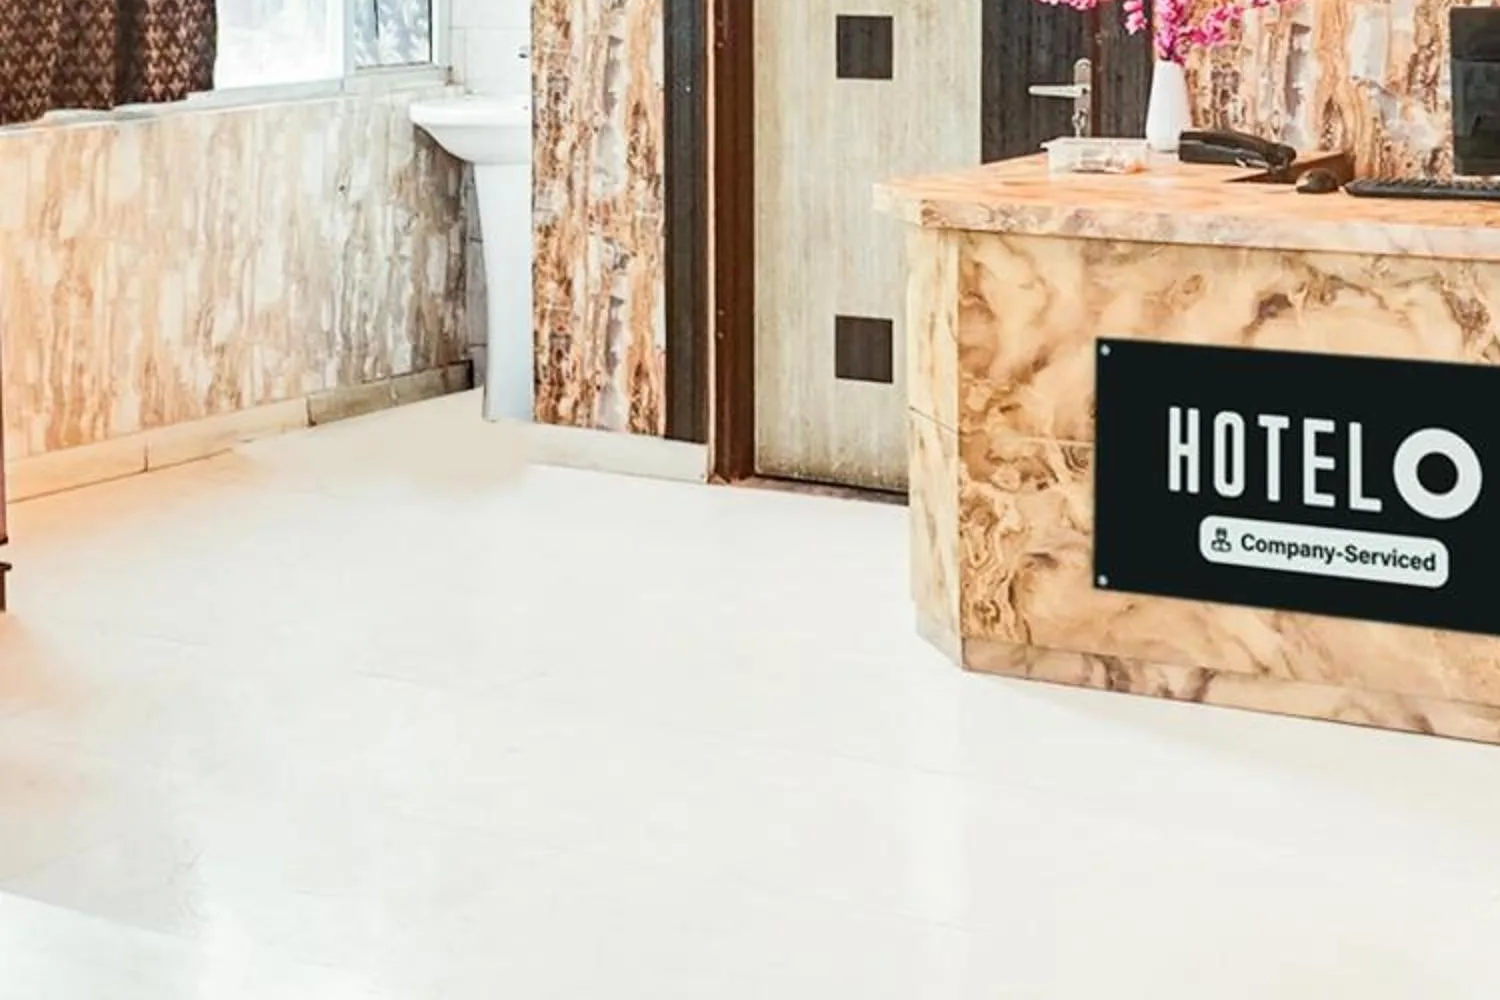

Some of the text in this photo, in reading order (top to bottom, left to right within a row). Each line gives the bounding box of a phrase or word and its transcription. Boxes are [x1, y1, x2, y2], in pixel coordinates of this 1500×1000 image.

[1169, 406, 1482, 520] HOTEL O
[1241, 533, 1437, 572] Company-Serviced
